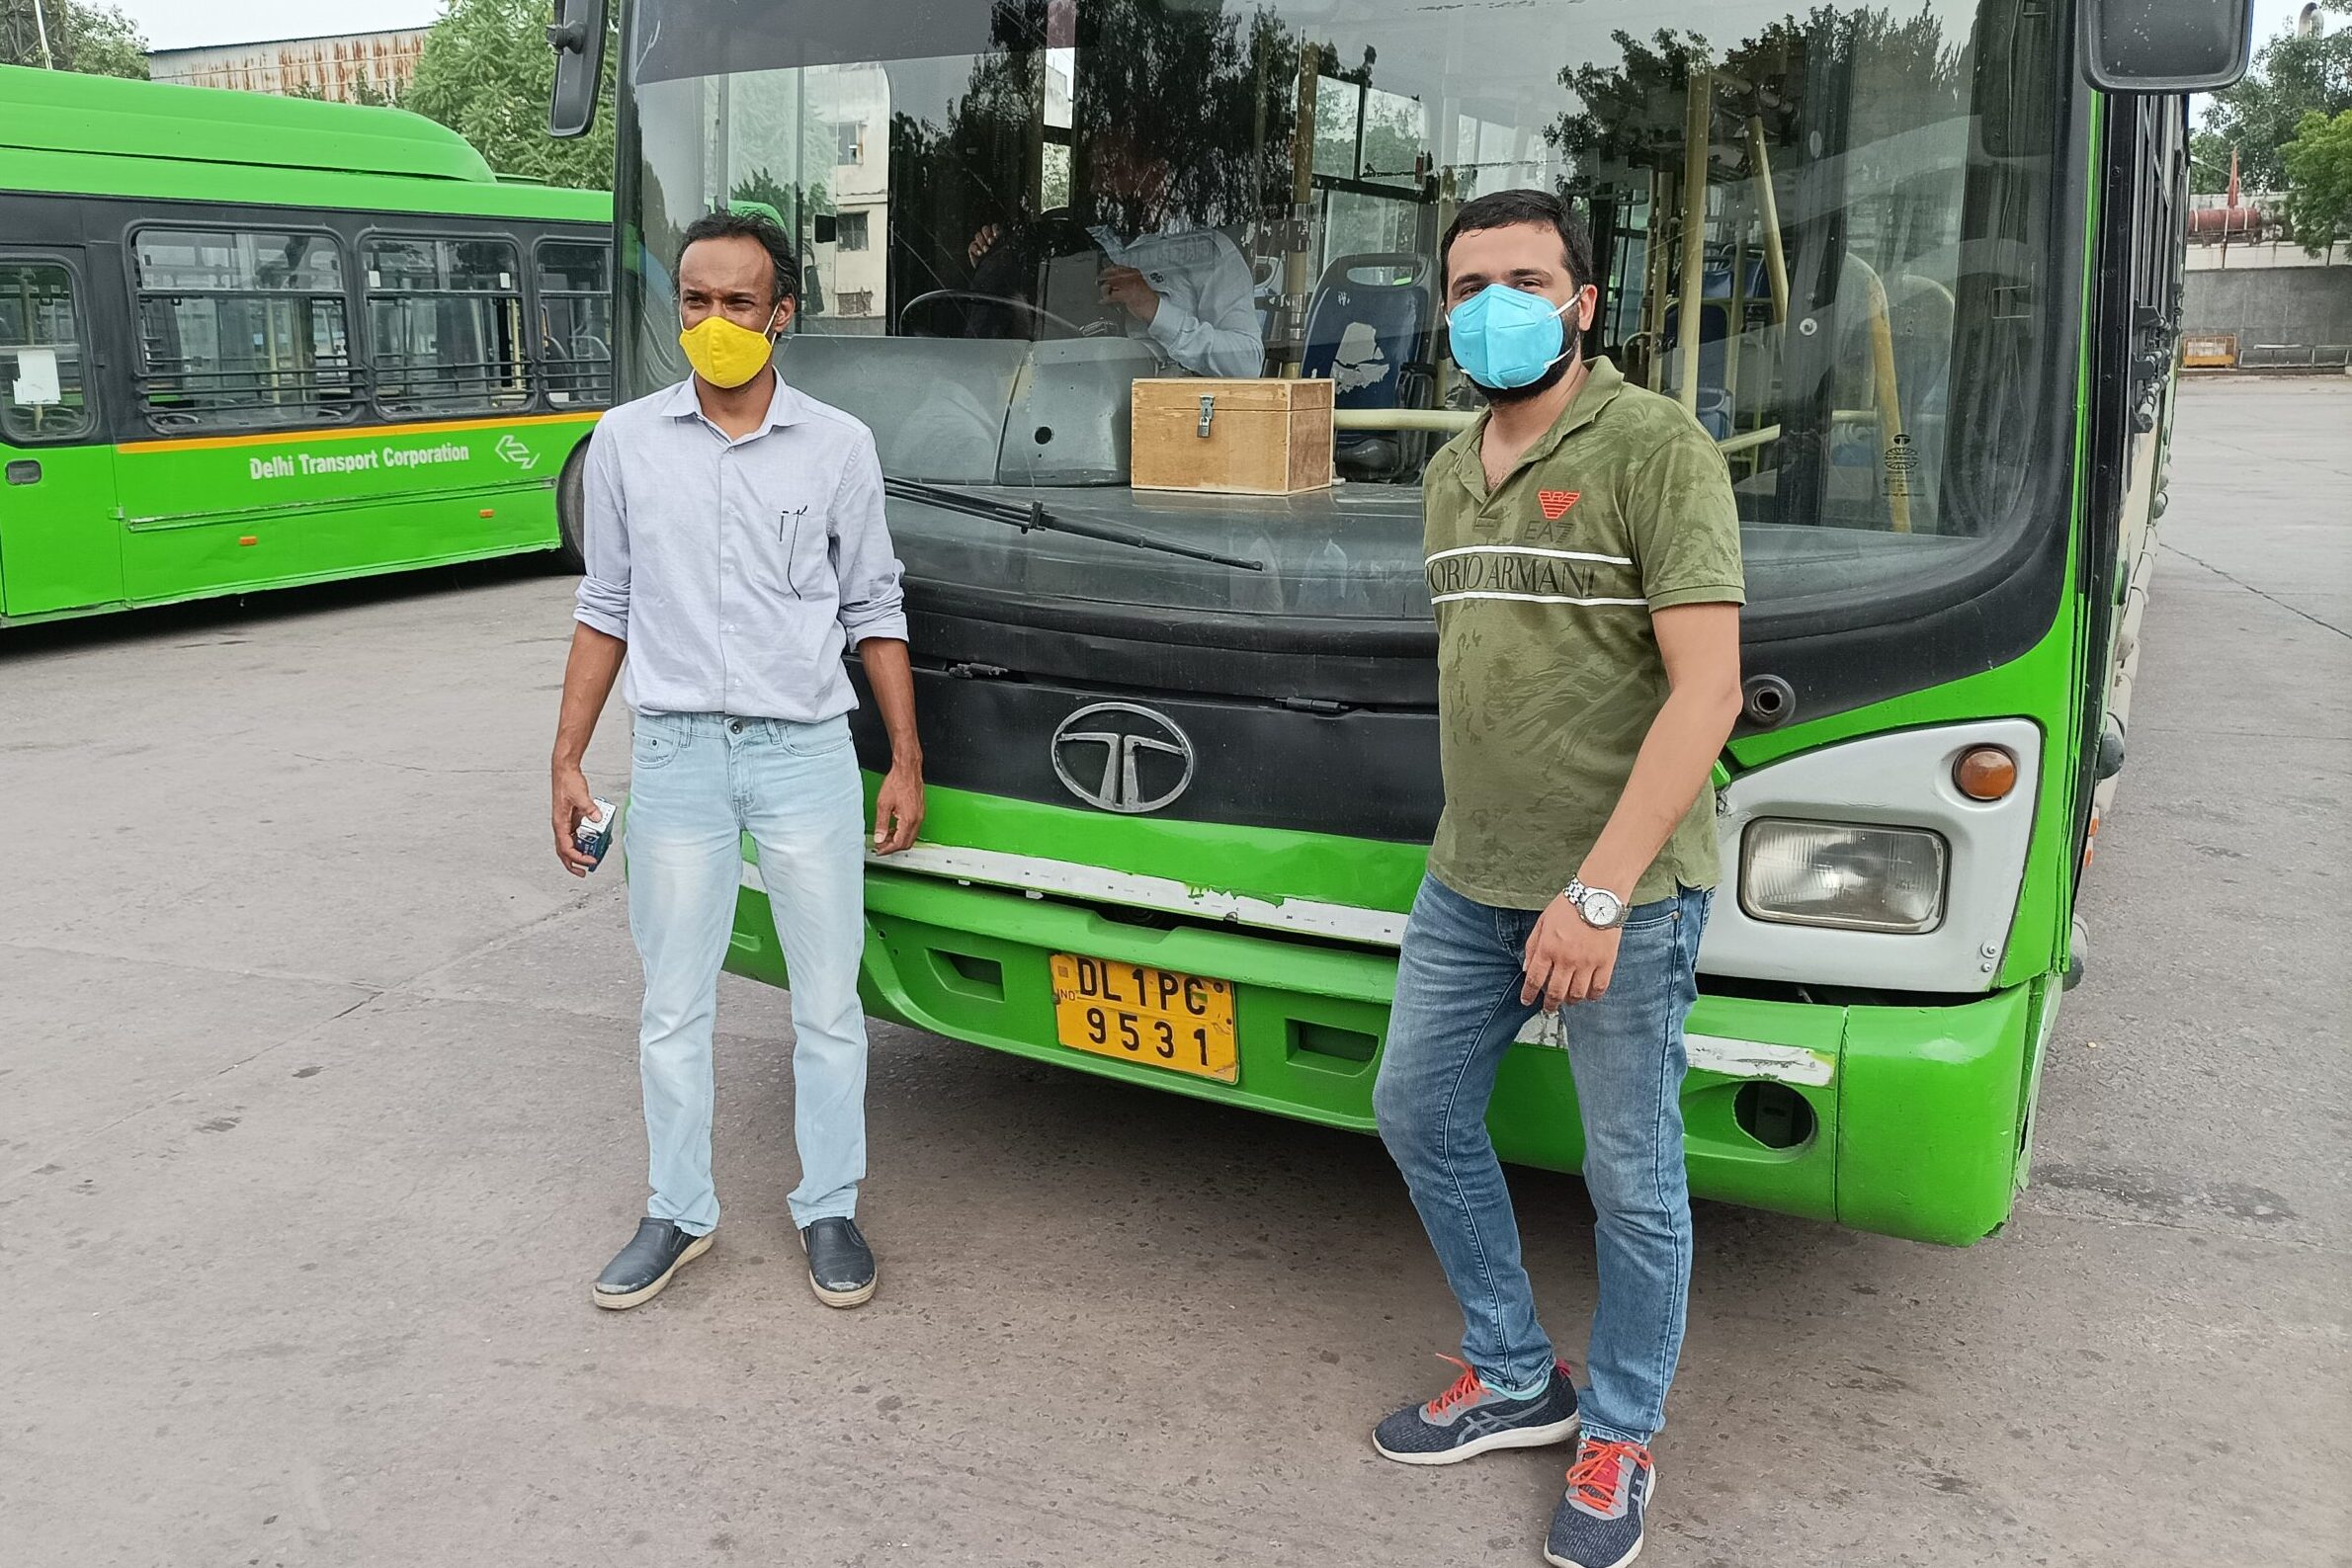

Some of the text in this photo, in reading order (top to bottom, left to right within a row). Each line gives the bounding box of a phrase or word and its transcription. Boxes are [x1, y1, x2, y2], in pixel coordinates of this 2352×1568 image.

[249, 443, 469, 479] Delhi Transport Corporation
[1484, 556, 1594, 597] ARMANI
[1087, 1007, 1208, 1066] 9531
